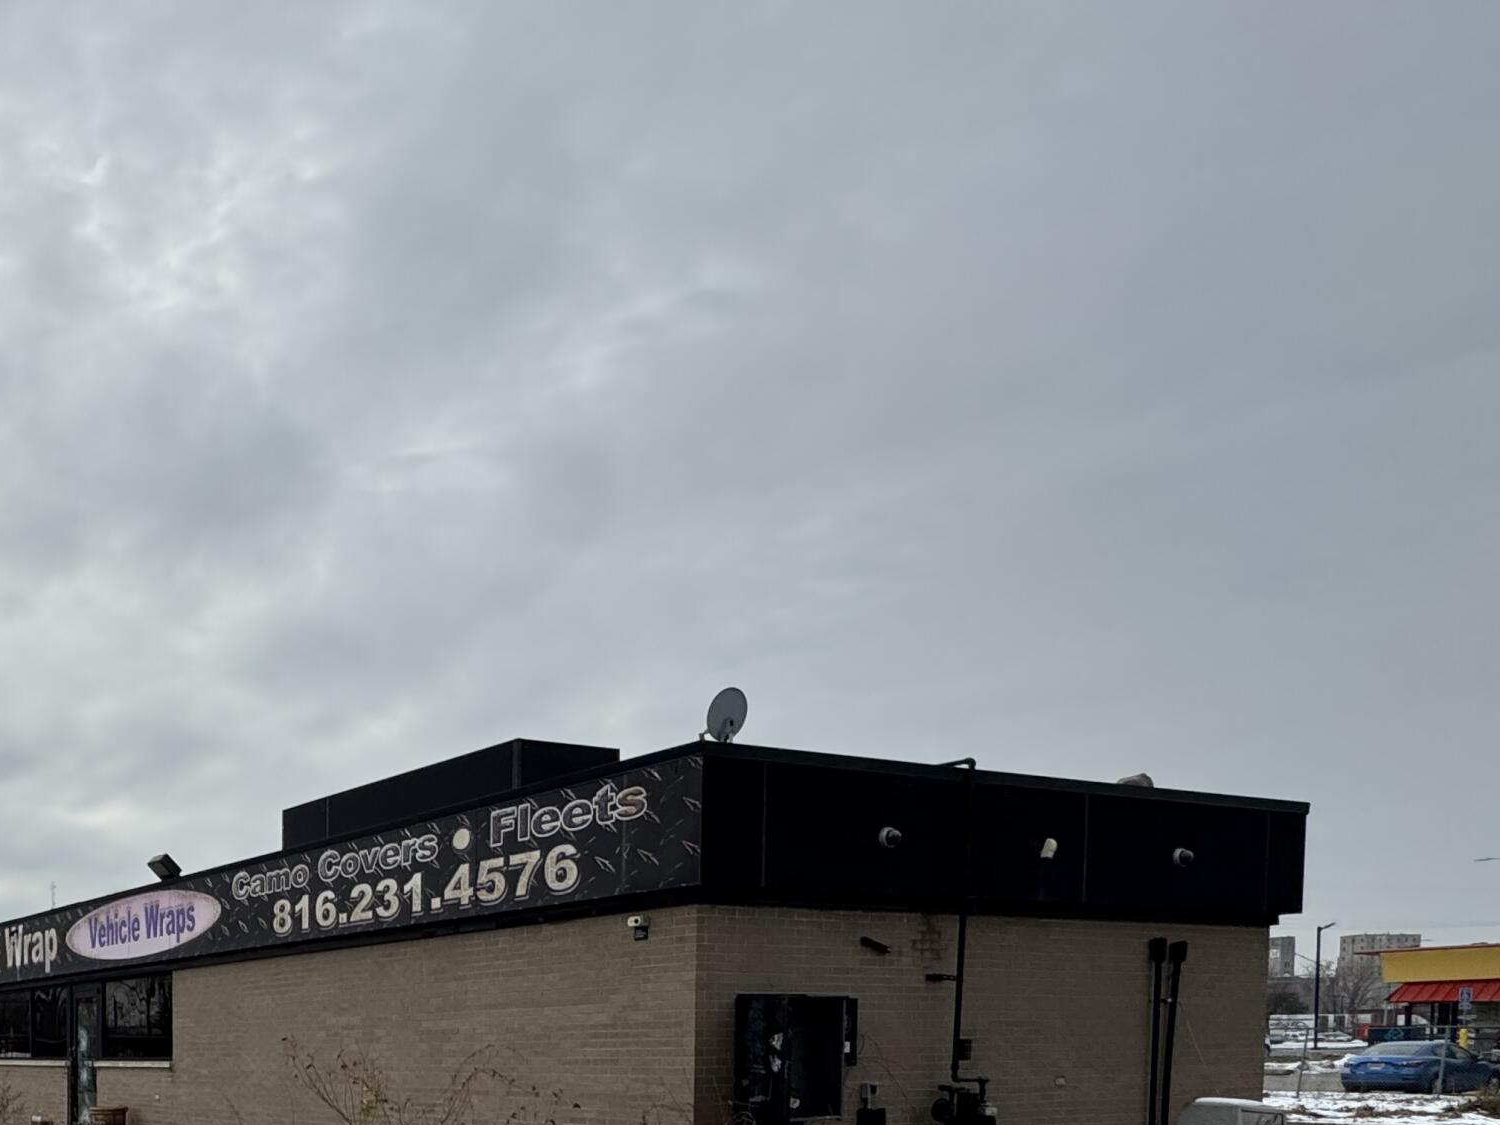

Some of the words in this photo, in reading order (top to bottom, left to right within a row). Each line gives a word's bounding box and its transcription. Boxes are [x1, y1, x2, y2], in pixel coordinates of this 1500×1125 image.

[232, 865, 309, 900] Camo
[318, 834, 438, 882] Covers
[490, 784, 647, 847] Fleets
[273, 844, 581, 935] 816.231.4576
[4, 924, 57, 973] Wrap
[89, 915, 140, 949] Vehicle
[145, 903, 196, 943] Wraps
